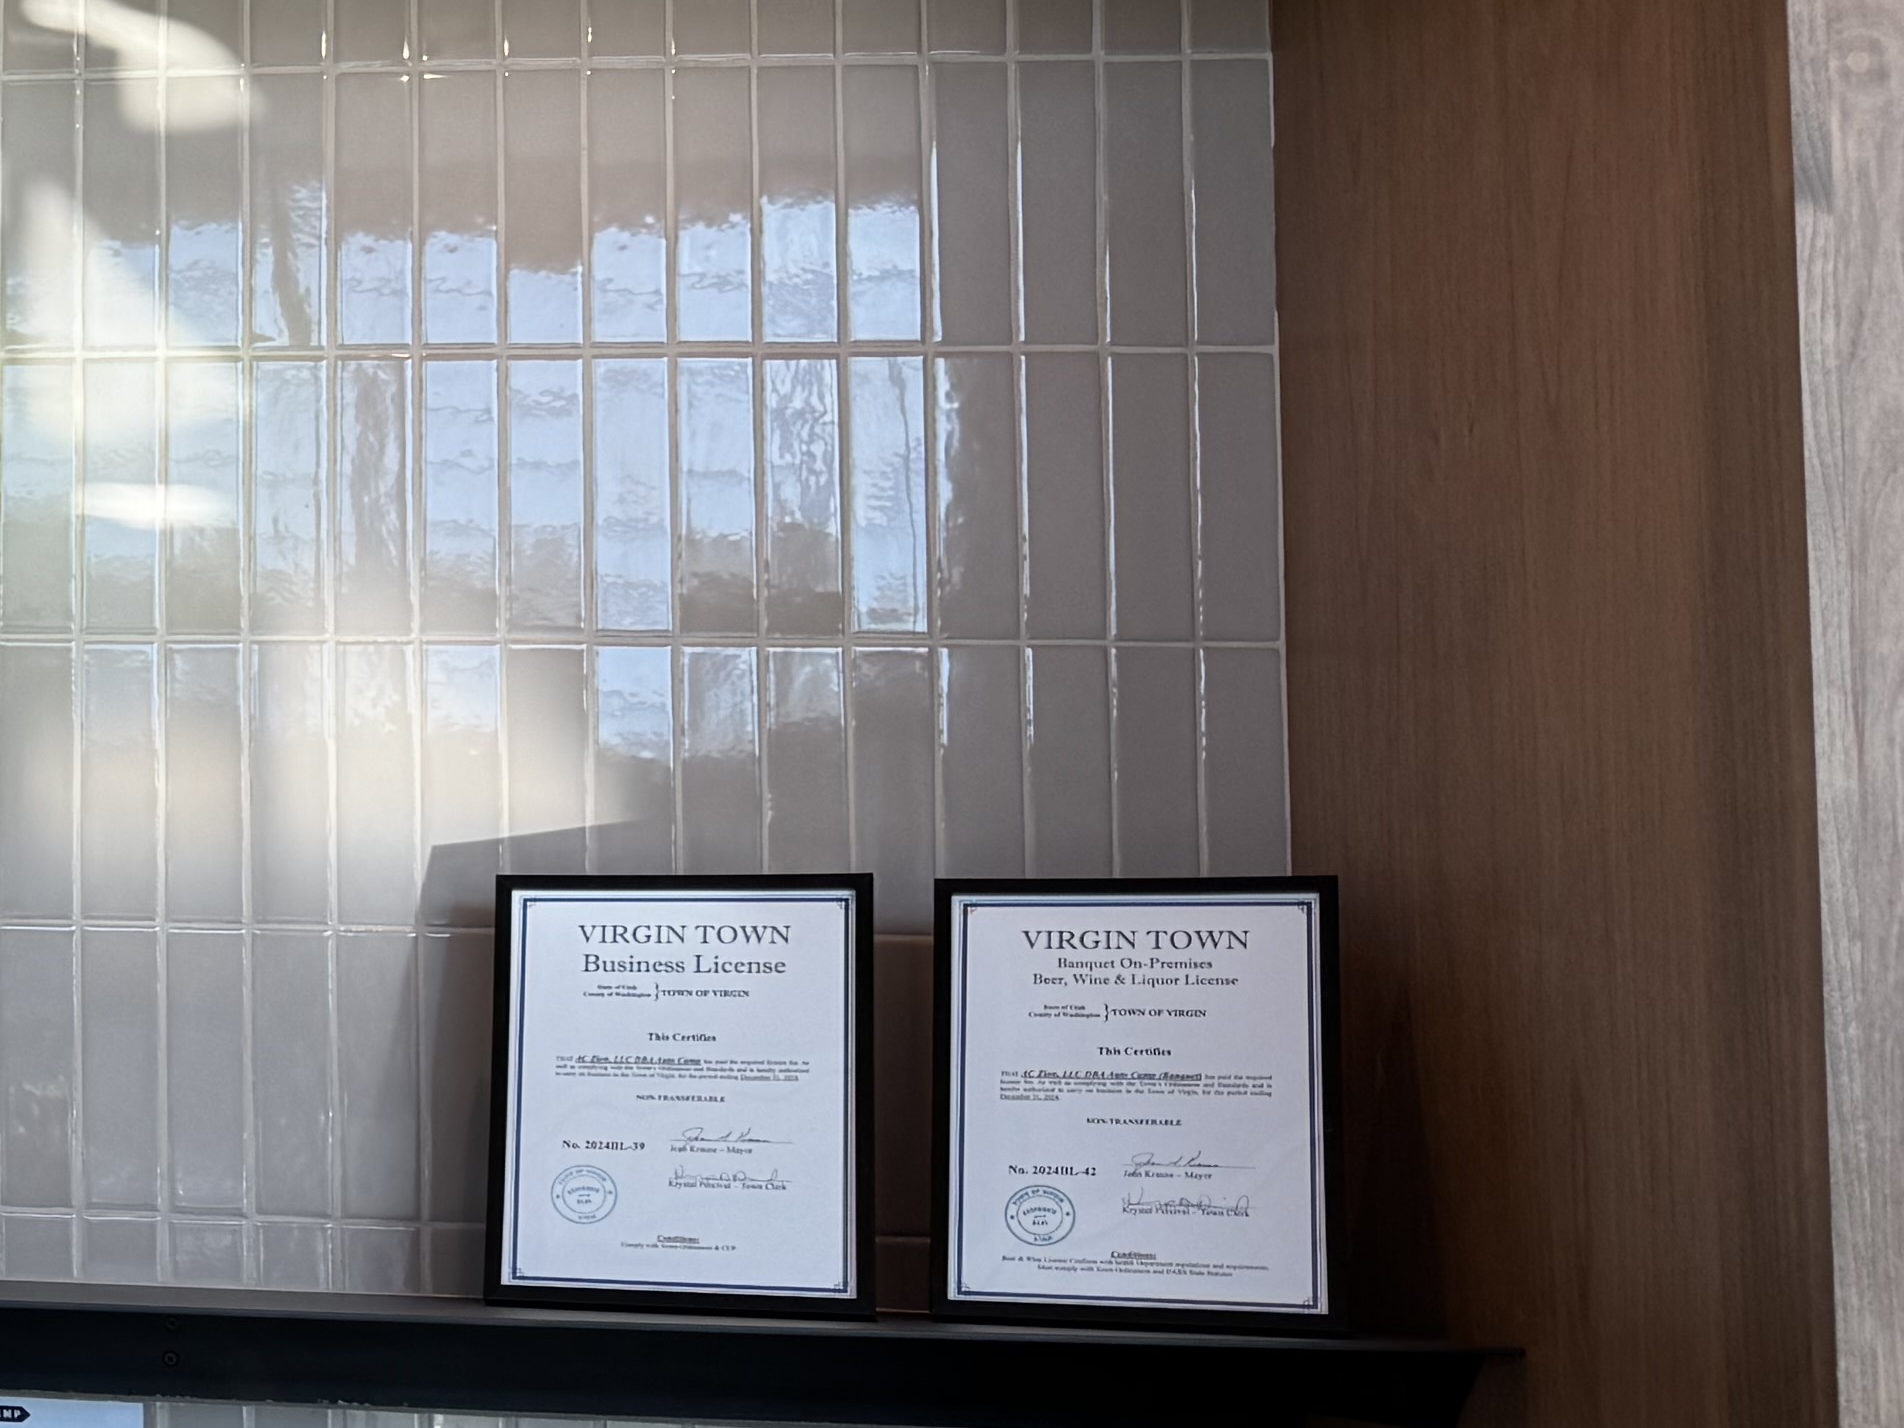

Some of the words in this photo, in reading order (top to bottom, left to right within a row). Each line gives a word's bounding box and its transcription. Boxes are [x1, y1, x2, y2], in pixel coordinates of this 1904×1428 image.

[578, 925, 686, 944] VIRGIN
[695, 925, 791, 944] TOWN
[1021, 930, 1138, 950] VIRGIN
[1146, 930, 1250, 950] TOWN
[582, 954, 685, 973] Business
[693, 955, 786, 973] License
[1058, 958, 1115, 971] Banquet
[1120, 958, 1213, 970] On-Premises
[1033, 973, 1068, 987] Beer,
[1073, 974, 1109, 985] Wine
[1115, 975, 1125, 985] &
[1131, 975, 1180, 988] Liquor
[1185, 975, 1239, 986] License
[1111, 1008, 1146, 1017] TOWN
[1149, 1009, 1164, 1017] OF
[1166, 1009, 1207, 1017] VIRGIN
[648, 1033, 670, 1042] This
[673, 1033, 716, 1042] Certifies
[1097, 1047, 1121, 1056] This
[1124, 1047, 1172, 1057] Certifies
[562, 1140, 581, 1149] No.
[1008, 1165, 1028, 1175] No.
